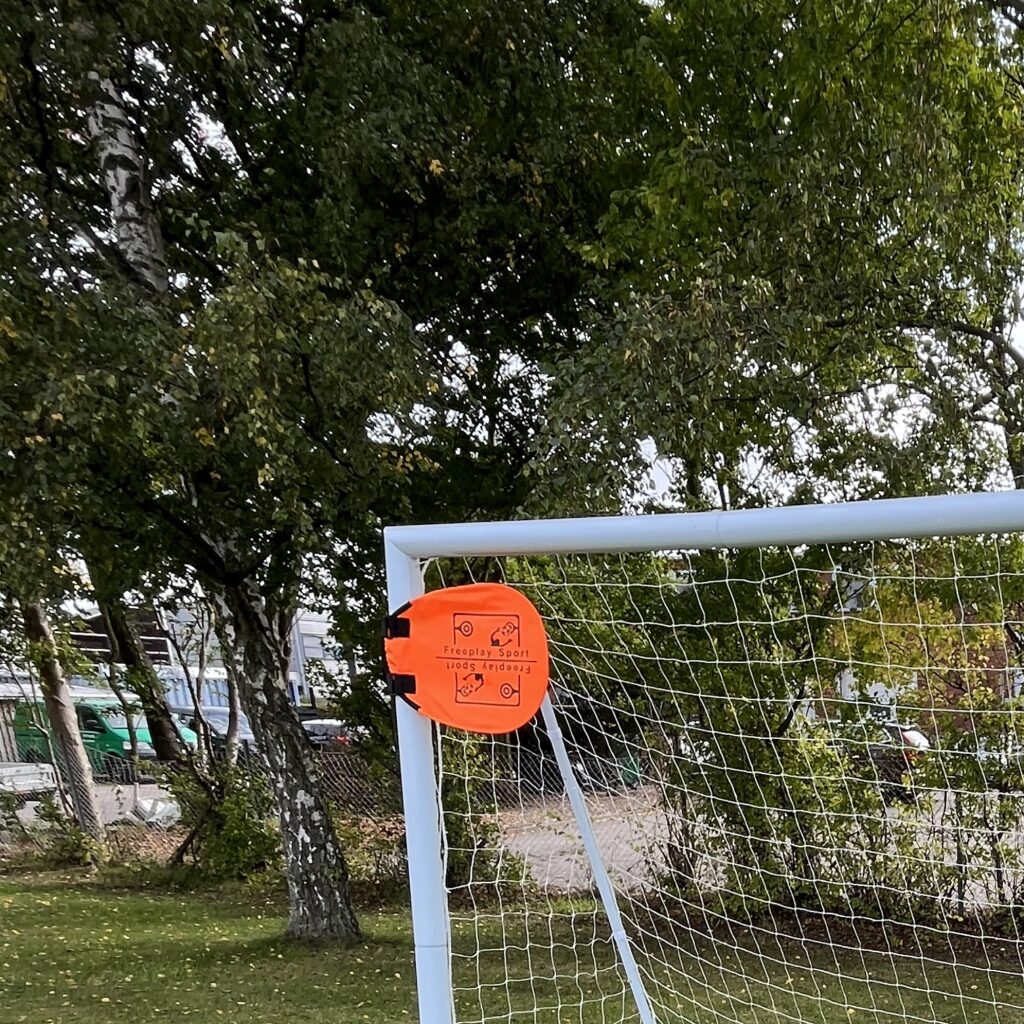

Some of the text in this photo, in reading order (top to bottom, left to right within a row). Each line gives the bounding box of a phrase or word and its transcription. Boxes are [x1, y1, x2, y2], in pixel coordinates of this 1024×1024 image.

[444, 646, 530, 658] Freeplay Sport
[446, 661, 531, 674] Freeplay Sport
